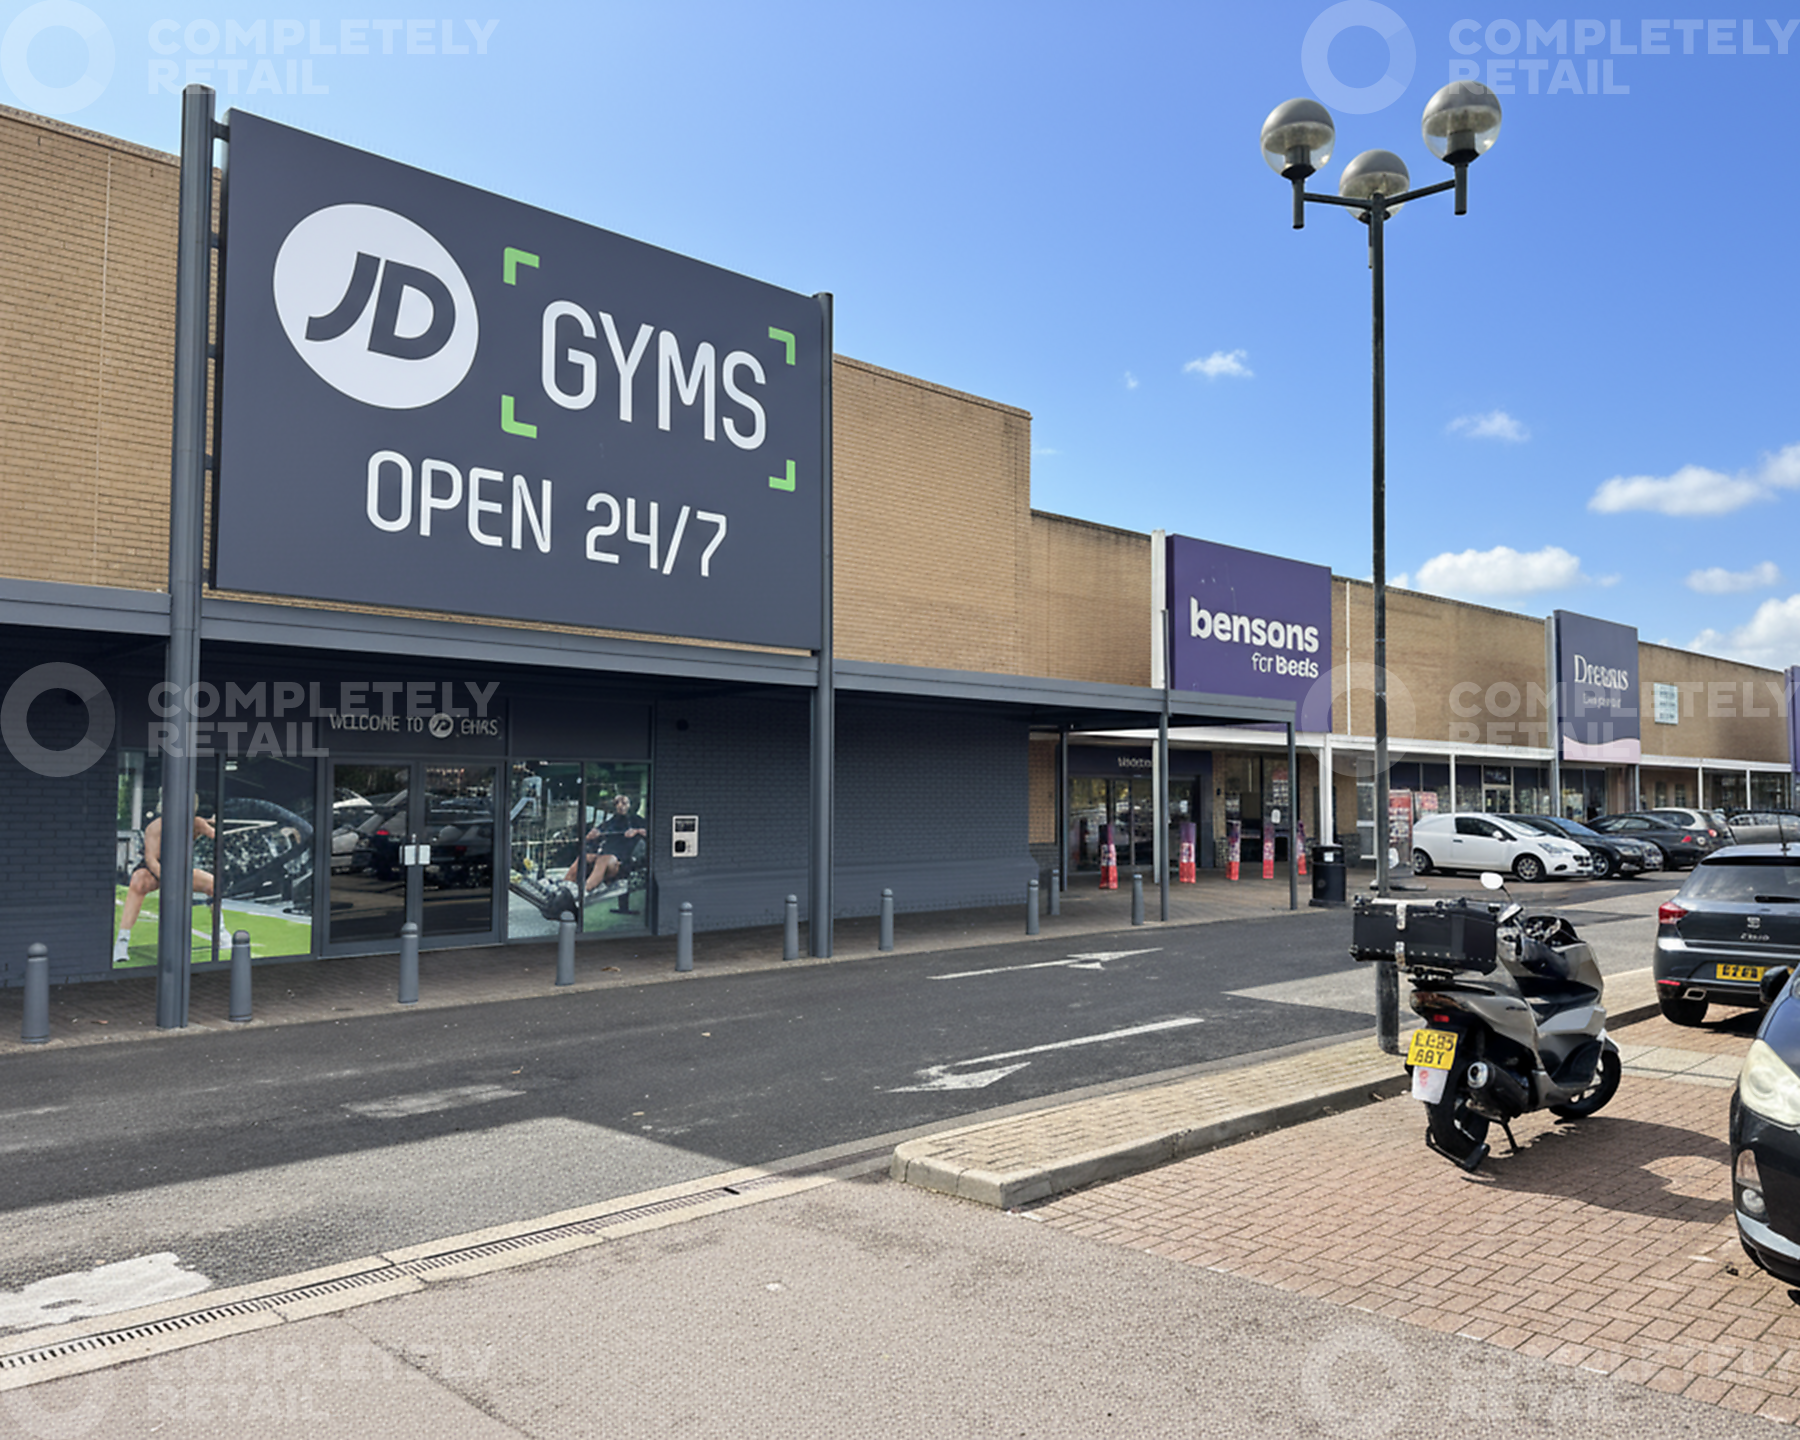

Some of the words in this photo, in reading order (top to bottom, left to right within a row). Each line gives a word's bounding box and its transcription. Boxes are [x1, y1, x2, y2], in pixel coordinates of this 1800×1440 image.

[304, 251, 456, 361] JD
[541, 299, 767, 450] GYMS
[366, 449, 552, 554] OPEN
[585, 491, 728, 577] 24/7
[1189, 596, 1320, 653] bensons
[1251, 652, 1274, 673] for
[1275, 655, 1320, 679] Beds
[406, 716, 423, 733] TO
